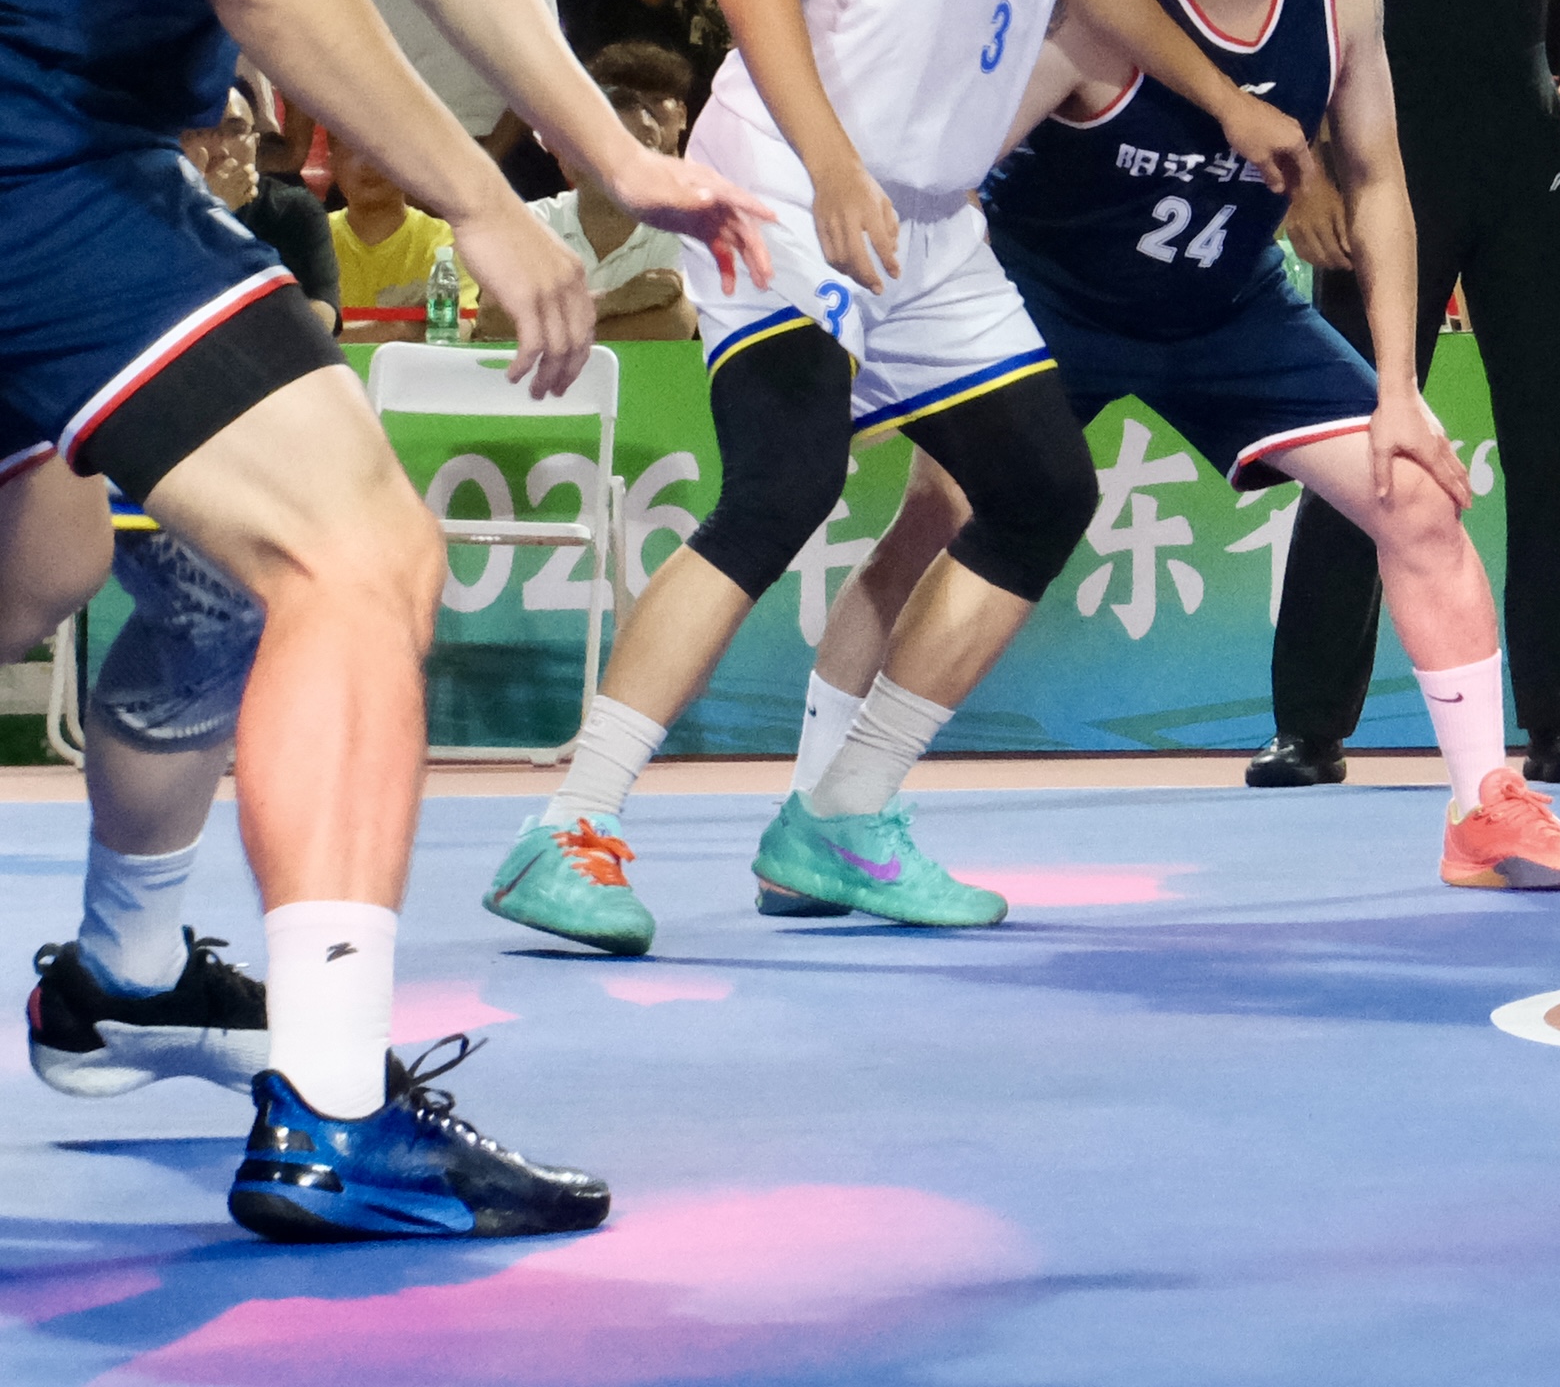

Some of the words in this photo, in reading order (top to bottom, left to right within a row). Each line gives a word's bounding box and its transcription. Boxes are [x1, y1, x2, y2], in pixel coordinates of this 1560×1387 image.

[980, 0, 1013, 74] 3
[1136, 195, 1237, 268] 24
[814, 279, 852, 339] 3
